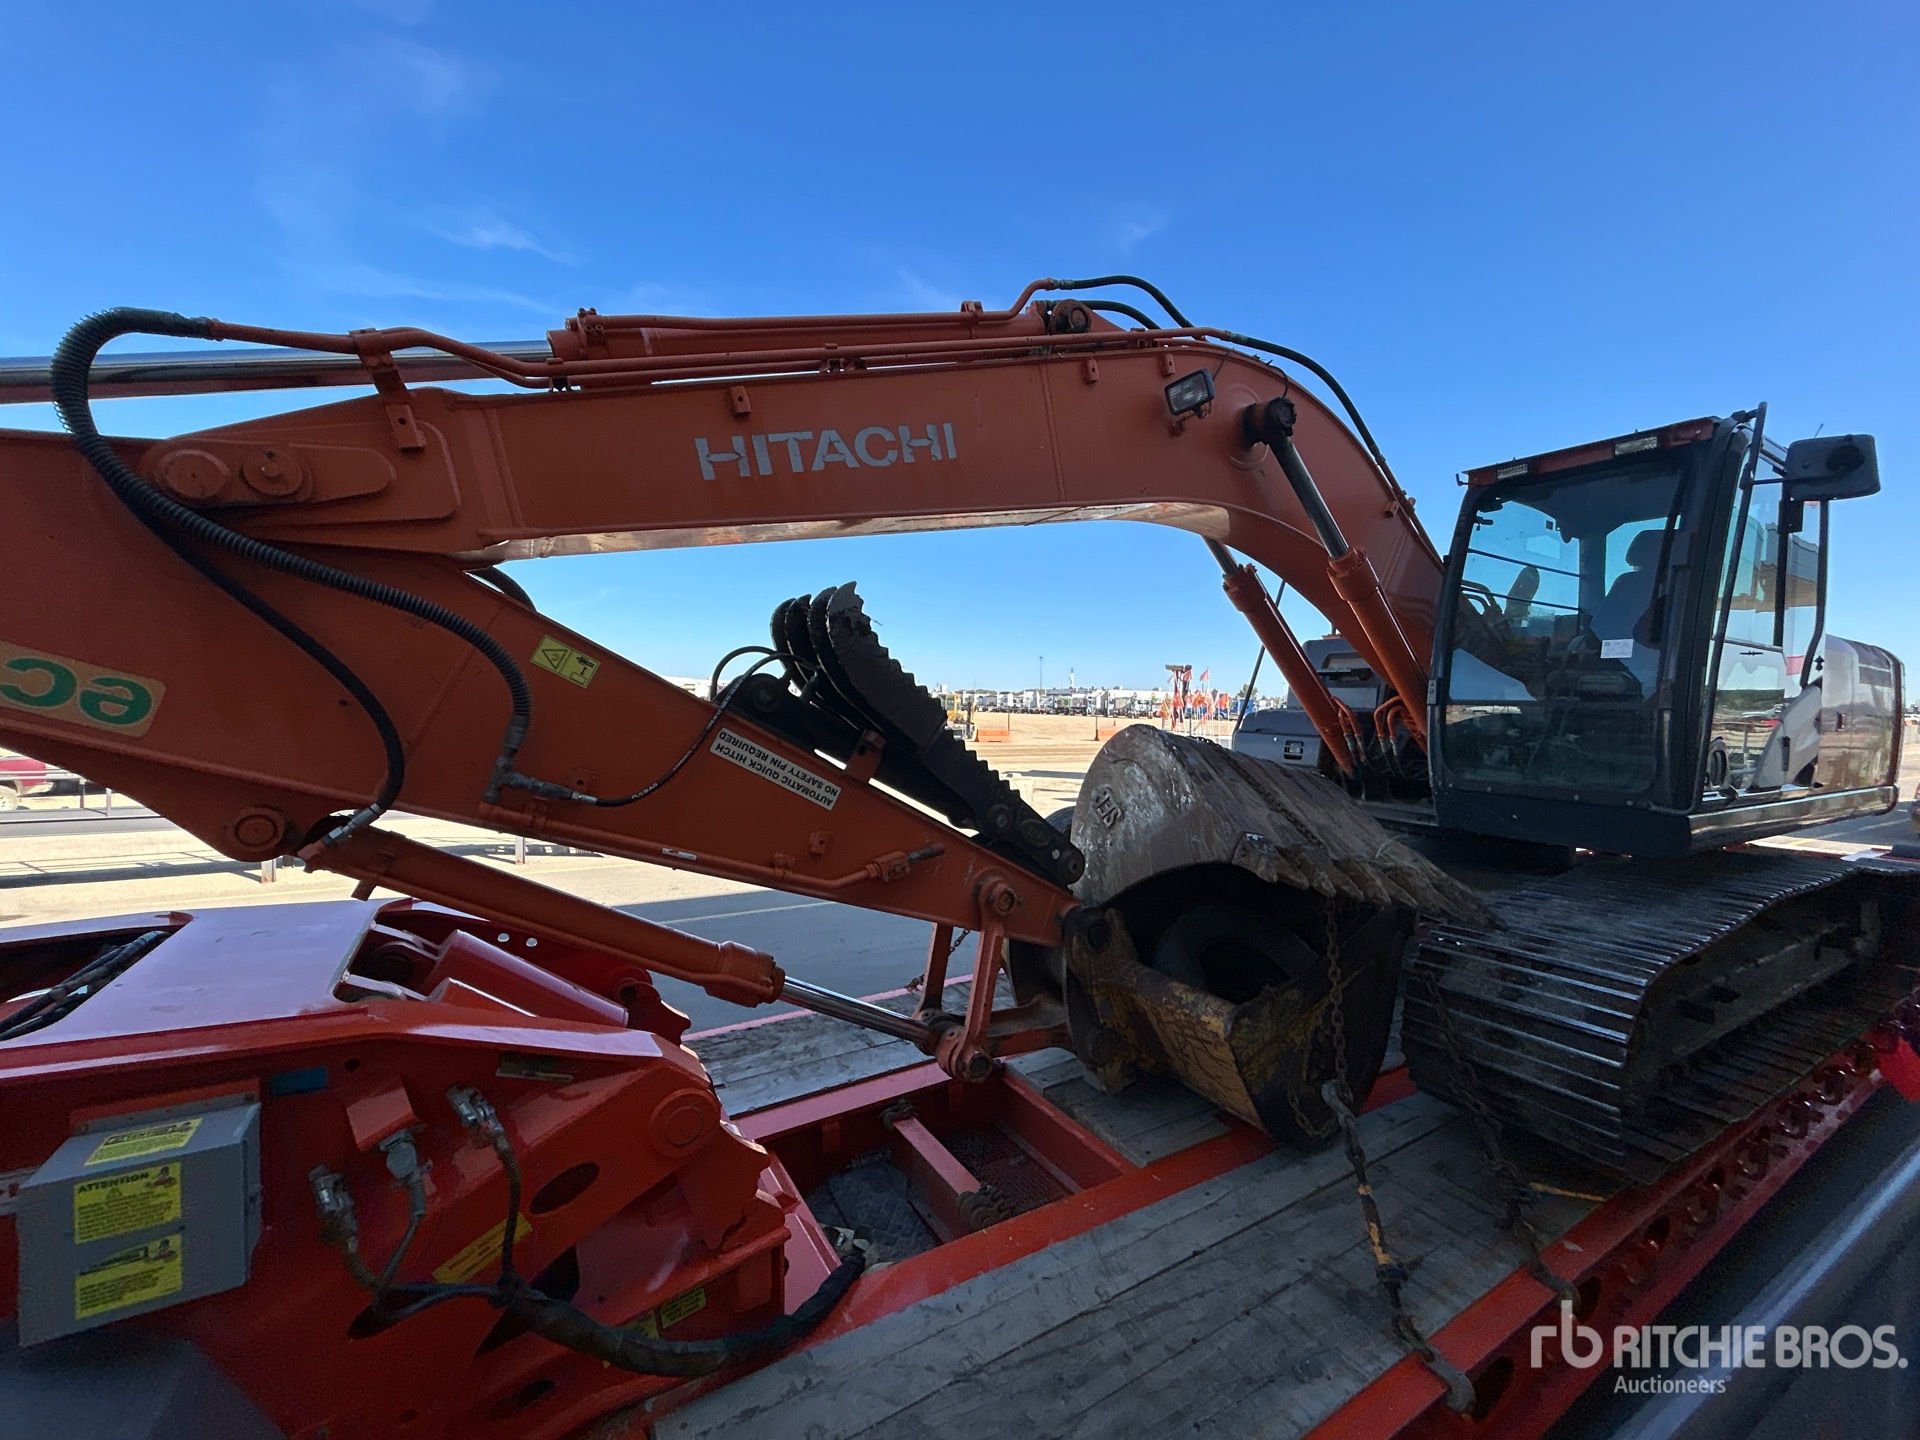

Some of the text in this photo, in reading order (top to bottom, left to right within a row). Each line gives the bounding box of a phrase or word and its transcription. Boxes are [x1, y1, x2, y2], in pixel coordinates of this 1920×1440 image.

[695, 422, 958, 481] HITACHI
[715, 743, 747, 765] HITCH
[718, 731, 839, 797] NO SAFETY PIN REQUIRED
[748, 760, 780, 781] QUICK
[781, 776, 834, 807] AUTOMATIC
[78, 1171, 150, 1193] ATTENTION
